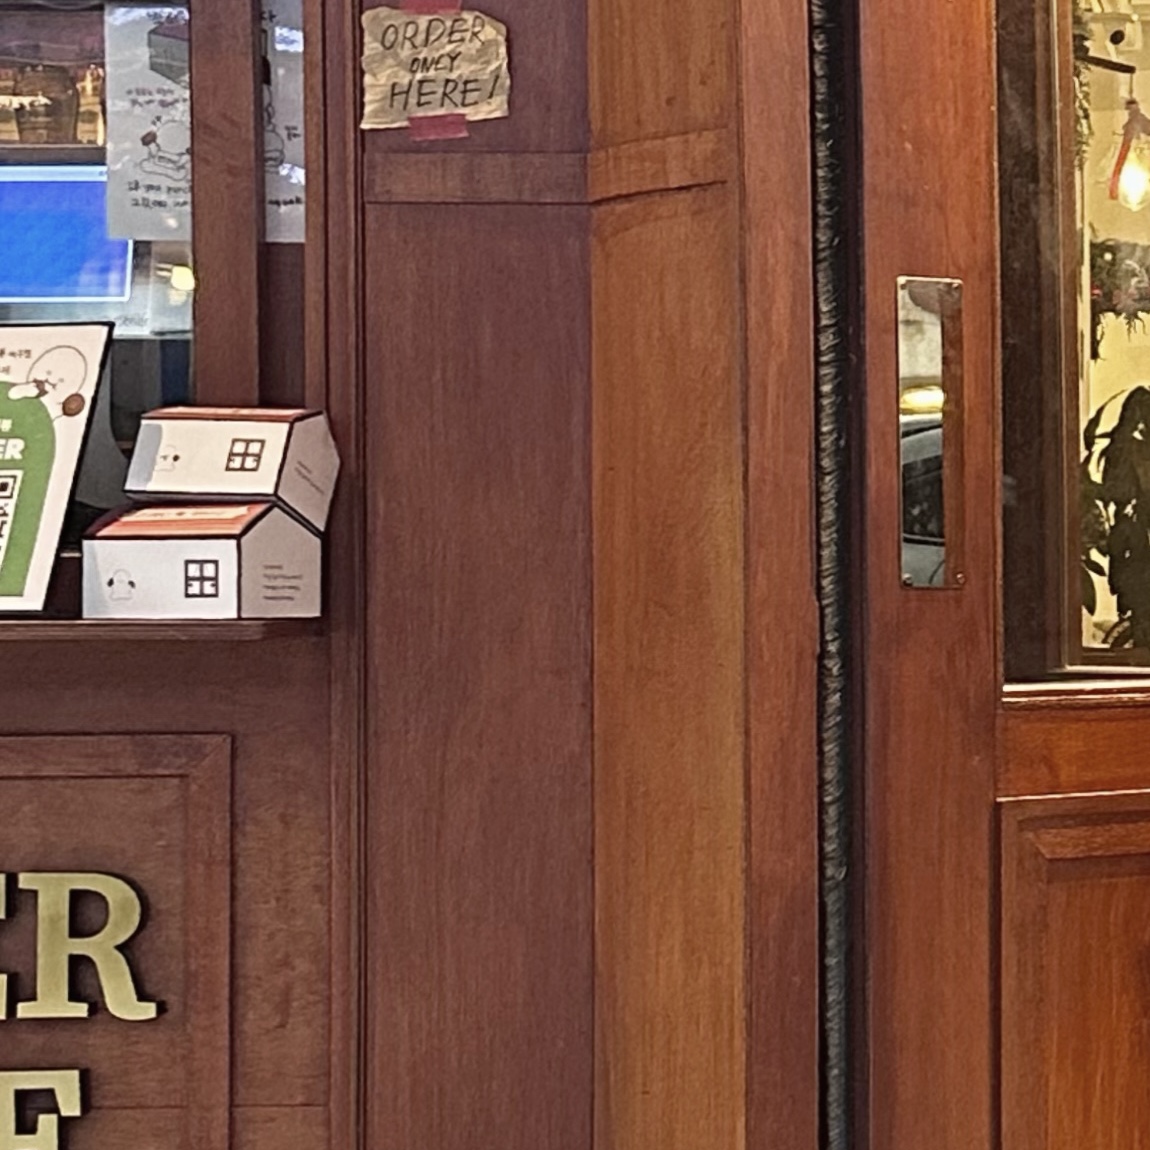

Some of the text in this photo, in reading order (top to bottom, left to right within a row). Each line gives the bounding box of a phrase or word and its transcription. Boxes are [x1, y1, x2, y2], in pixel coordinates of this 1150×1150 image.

[380, 15, 485, 50] ORDER
[389, 74, 500, 111] HERE!
[0, 872, 158, 1022] R
